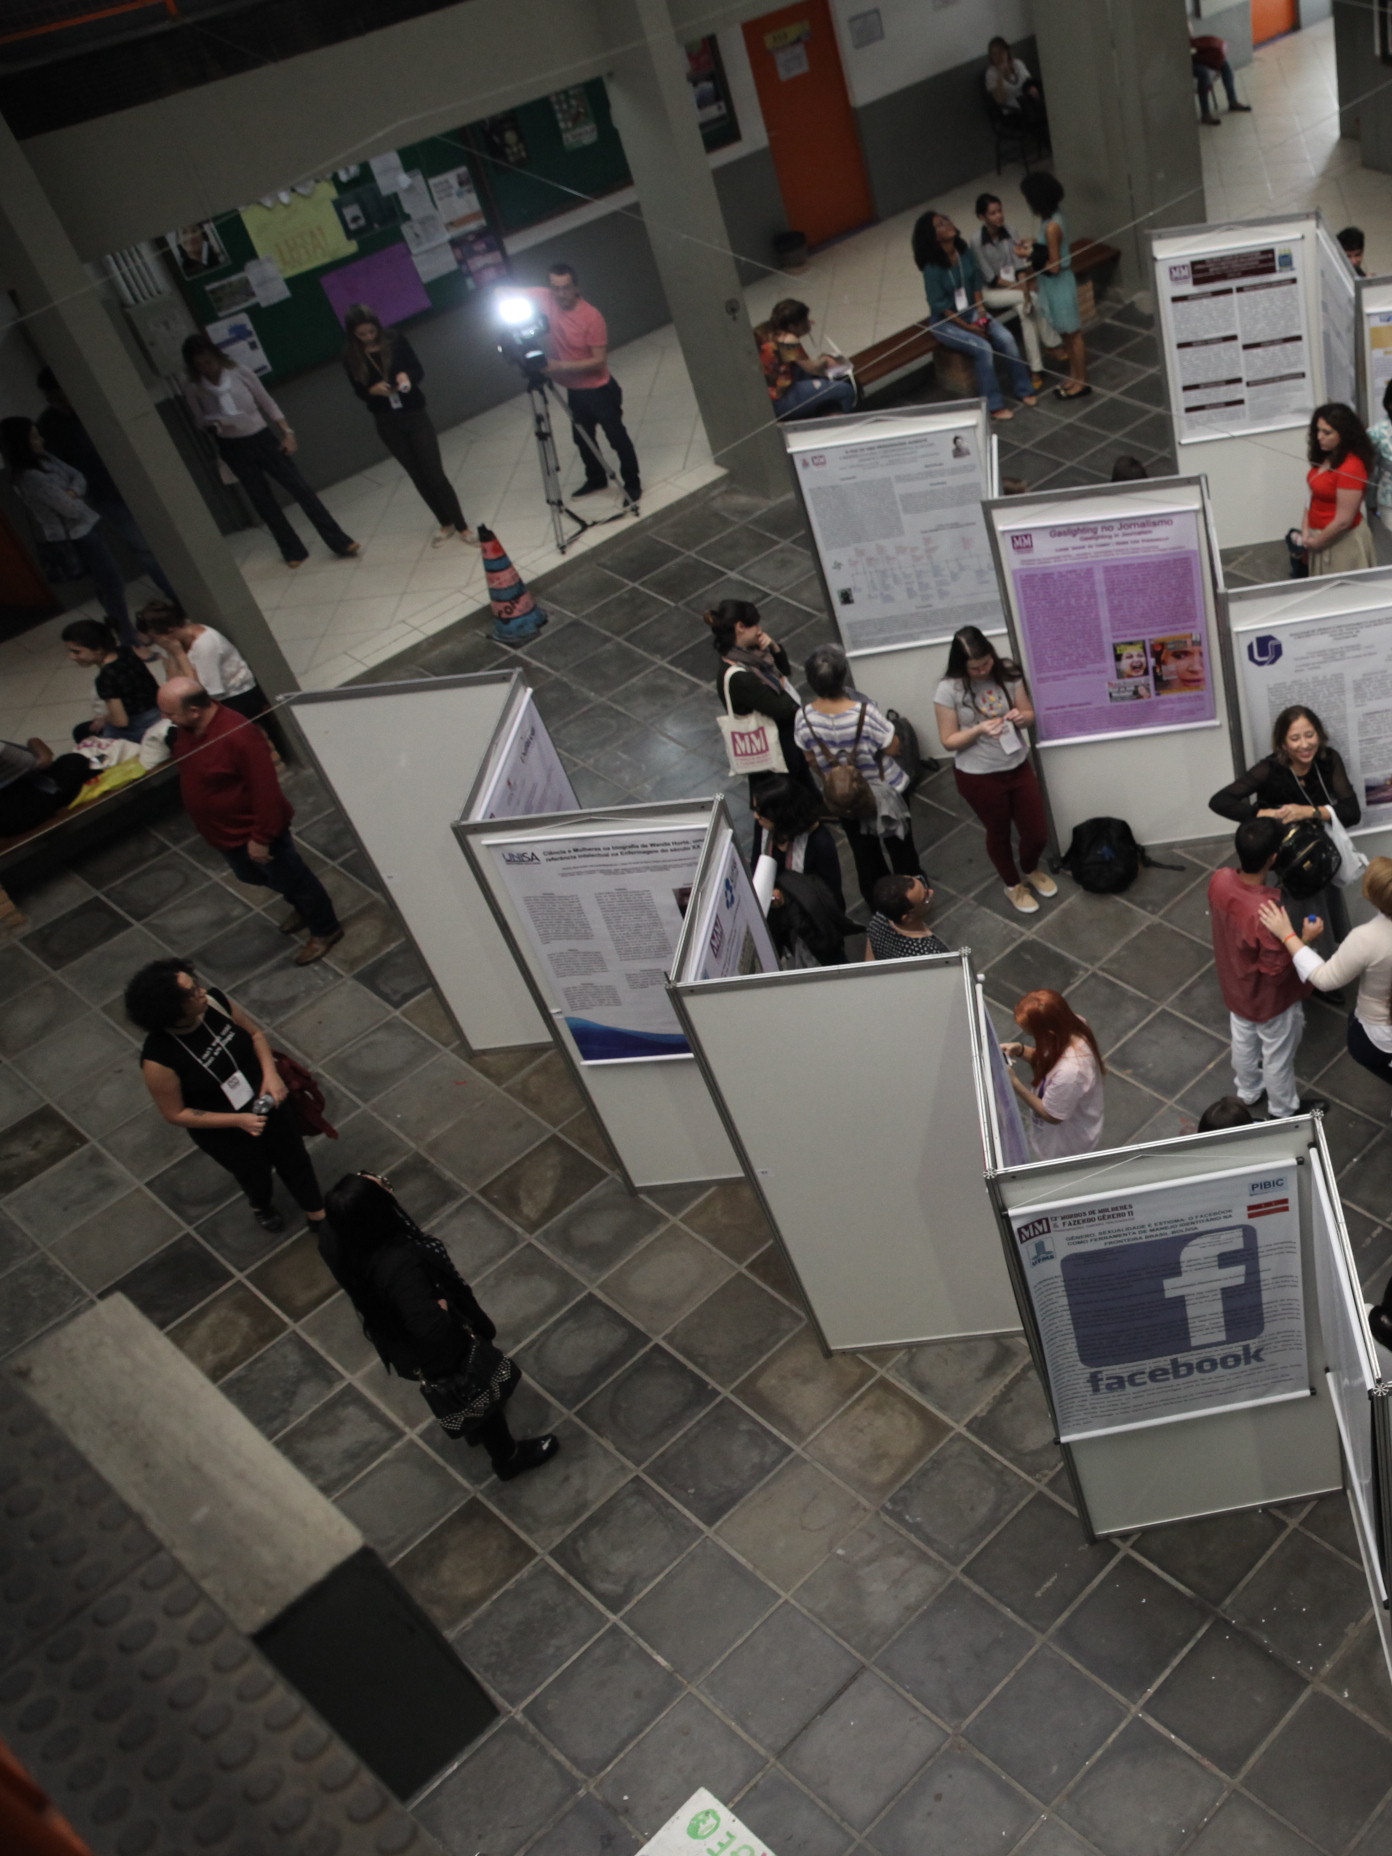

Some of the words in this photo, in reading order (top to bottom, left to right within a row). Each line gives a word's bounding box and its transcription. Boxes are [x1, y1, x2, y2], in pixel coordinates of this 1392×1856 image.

[1049, 526, 1098, 538] Gaslighting
[1101, 523, 1114, 532] no
[1117, 518, 1173, 531] Jornalismo
[734, 728, 767, 756] MM
[502, 850, 541, 864] UNISA
[1250, 1178, 1285, 1192] PIBIC
[1195, 1209, 1233, 1220] FACEBOOK
[1019, 1219, 1050, 1242] MM
[1086, 1343, 1266, 1394] facebook
